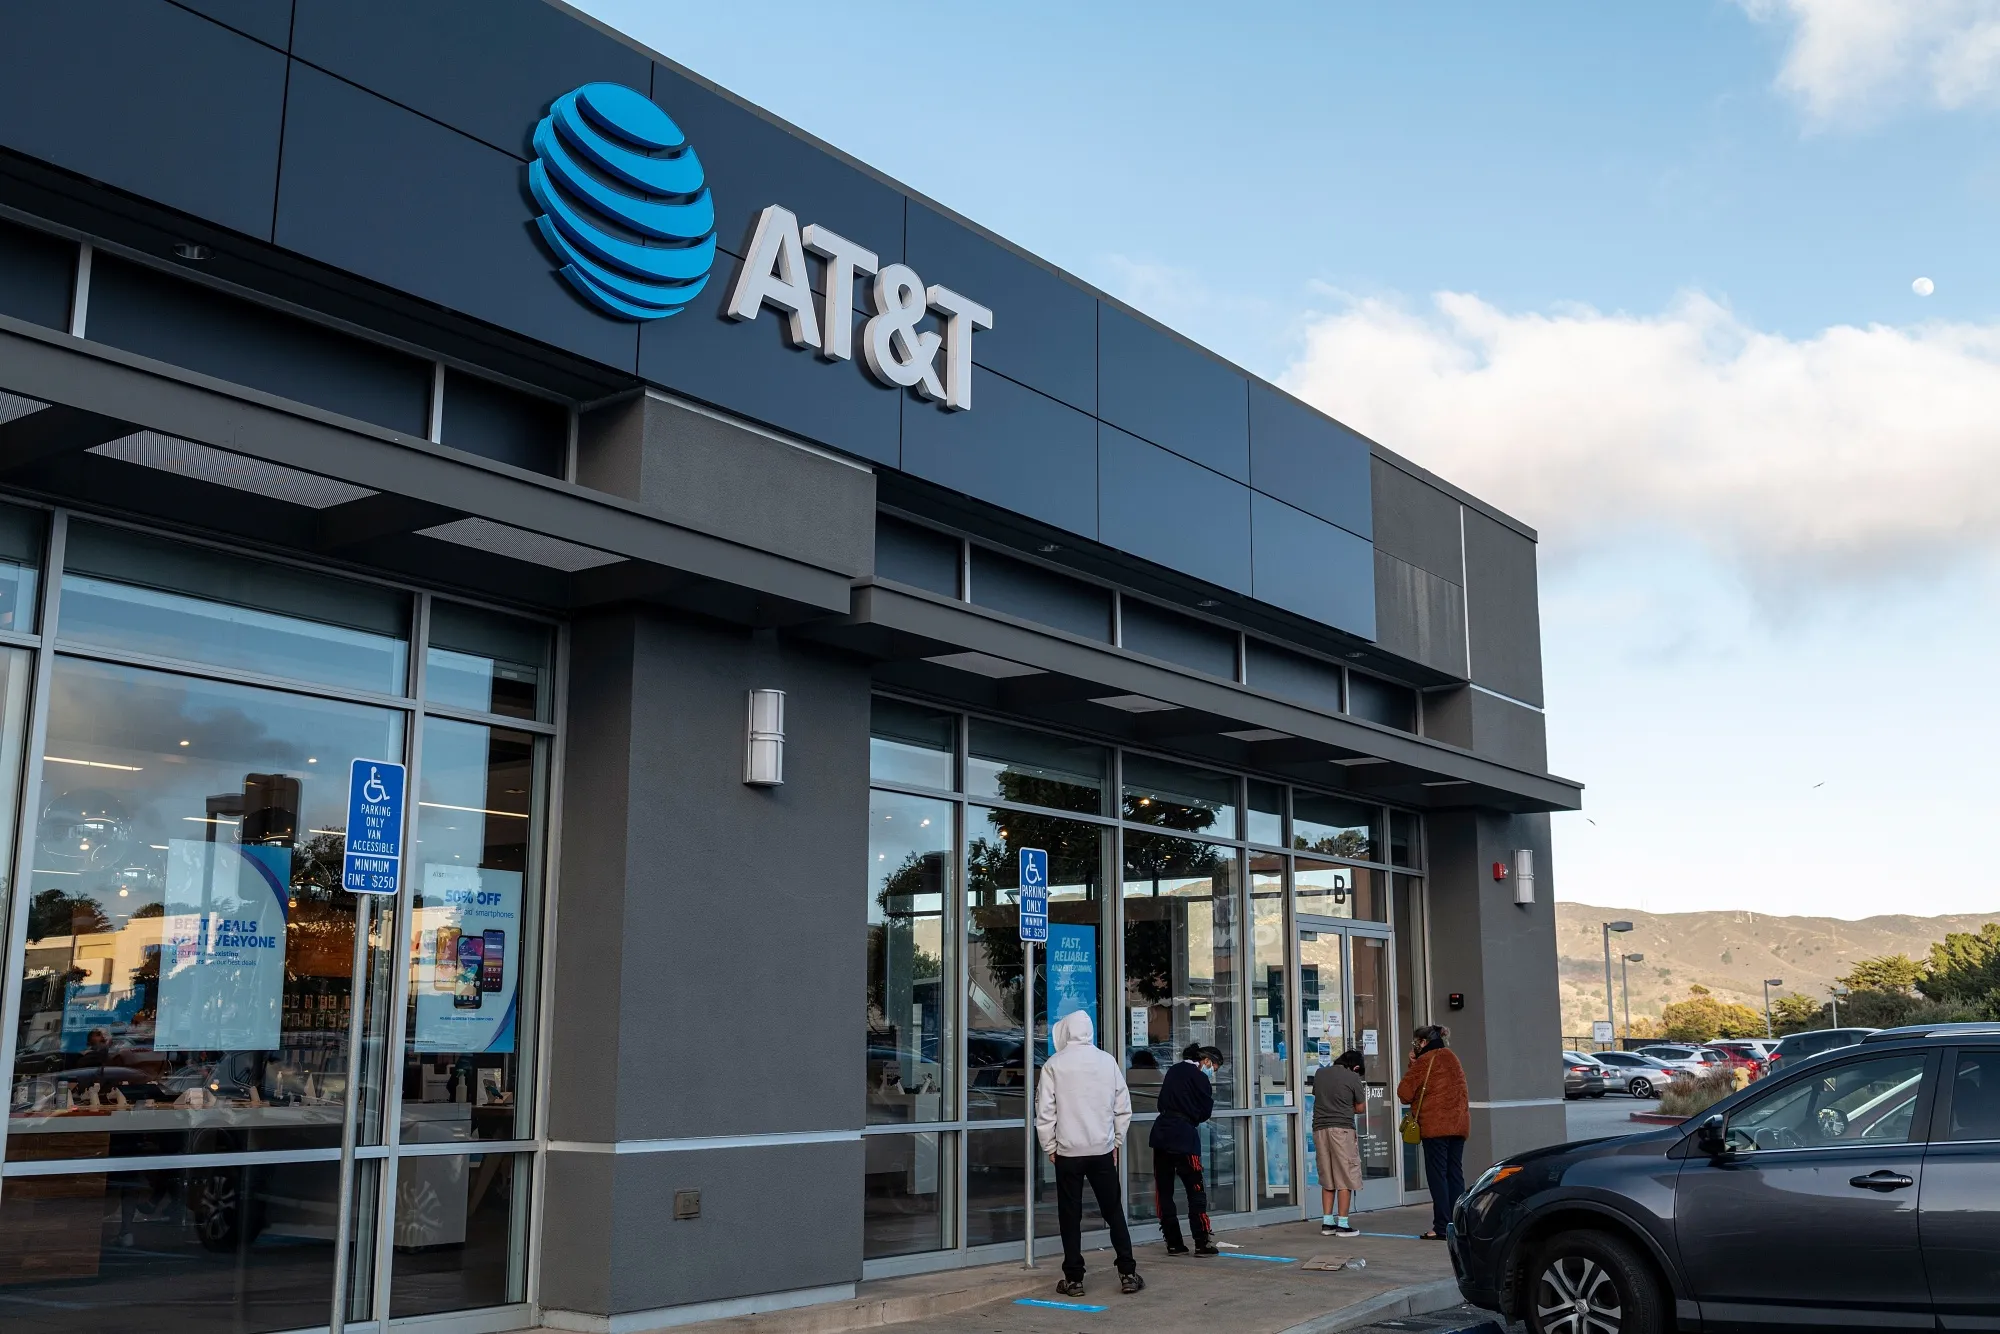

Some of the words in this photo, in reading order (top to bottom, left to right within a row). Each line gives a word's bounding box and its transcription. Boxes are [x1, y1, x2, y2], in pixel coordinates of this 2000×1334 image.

[727, 203, 993, 411] AT&T
[360, 803, 391, 817] PARKING
[366, 816, 385, 828] ONLY
[367, 828, 381, 840] VAN
[352, 840, 394, 854] ACCESSIBLE
[354, 858, 390, 873] MINIMUM
[347, 873, 366, 887] FINE
[371, 874, 394, 889] $250
[1021, 884, 1046, 899] PARKING
[1333, 874, 1346, 905] B
[445, 889, 474, 904] 50%
[476, 892, 502, 906] OFF
[1026, 899, 1042, 913] ONLY
[475, 910, 514, 919] smartphones
[1024, 916, 1043, 926] MINIMUM
[1022, 927, 1032, 936] FINE
[1061, 937, 1081, 951] FAST,
[1054, 951, 1090, 963] RELIABLE
[1370, 1087, 1384, 1099] AT&T
